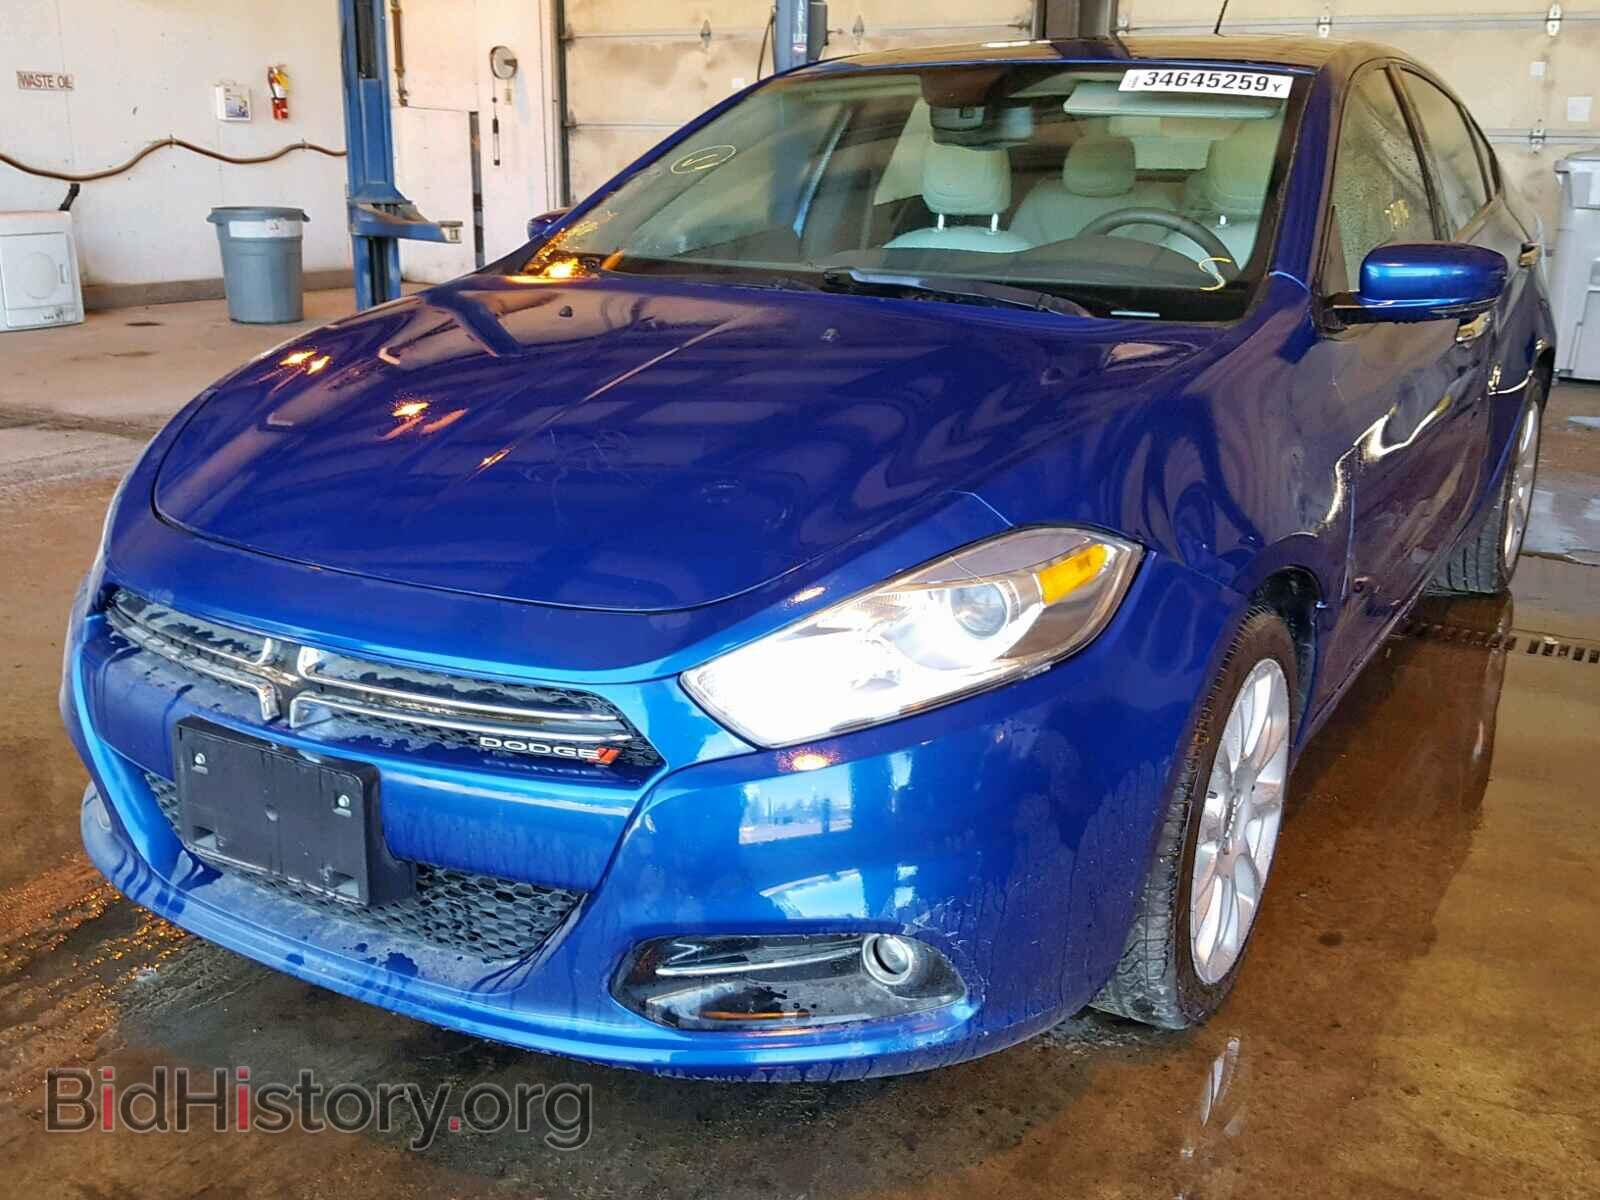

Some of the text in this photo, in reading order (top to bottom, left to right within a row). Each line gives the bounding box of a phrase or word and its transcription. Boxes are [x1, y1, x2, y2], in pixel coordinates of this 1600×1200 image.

[17, 73, 73, 89] WASTE OIL
[1143, 71, 1269, 92] 34645259
[479, 736, 601, 761] DODGE
